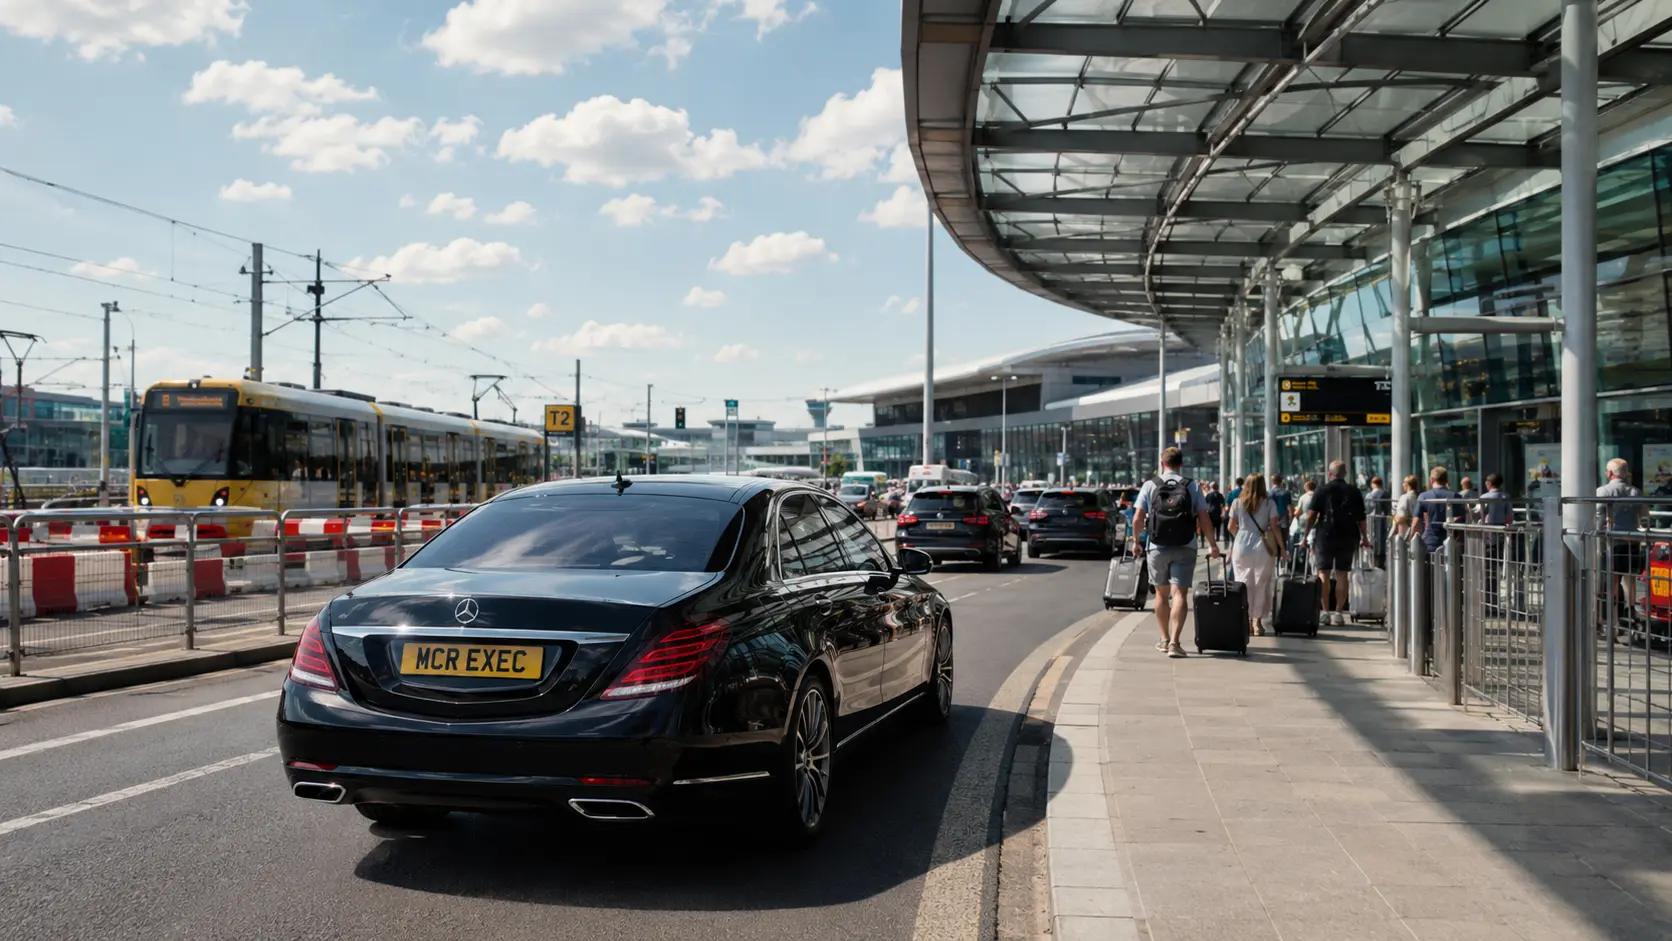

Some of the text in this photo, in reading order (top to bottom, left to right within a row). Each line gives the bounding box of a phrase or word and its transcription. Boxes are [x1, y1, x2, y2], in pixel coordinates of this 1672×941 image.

[549, 410, 570, 426] T2
[416, 647, 528, 673] MCR EXEC
